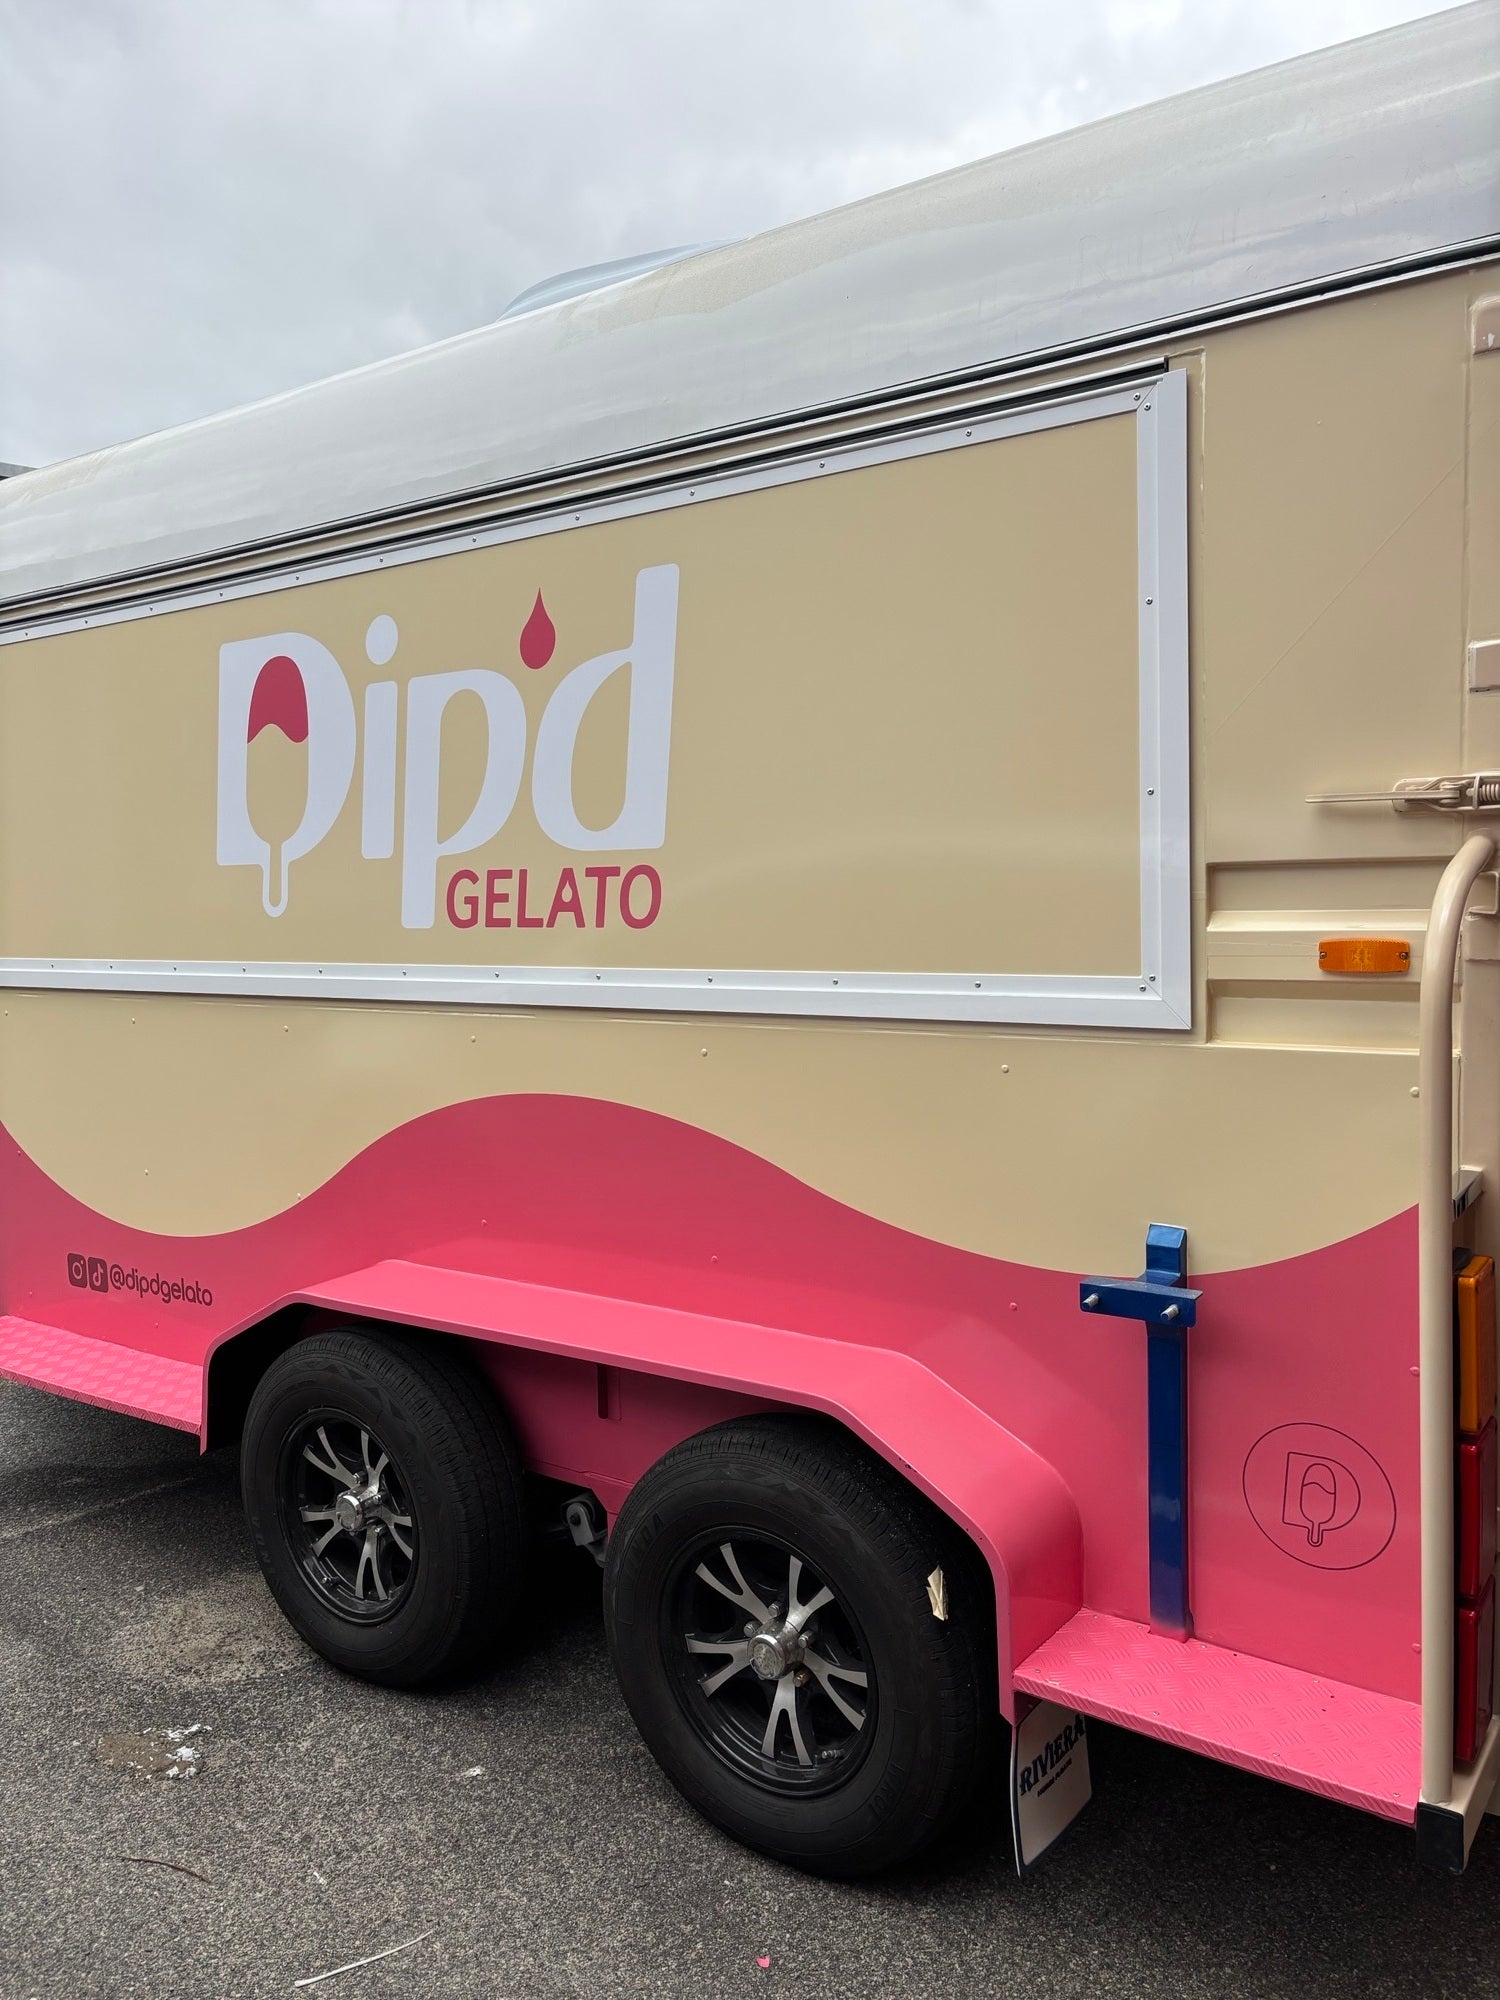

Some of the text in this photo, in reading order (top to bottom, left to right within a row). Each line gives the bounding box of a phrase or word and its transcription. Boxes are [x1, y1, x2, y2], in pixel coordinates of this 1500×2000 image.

[446, 864, 662, 930] GELATO
[110, 1264, 213, 1307] @dipdgelato
[1020, 1713, 1085, 1796] RIVIERA
